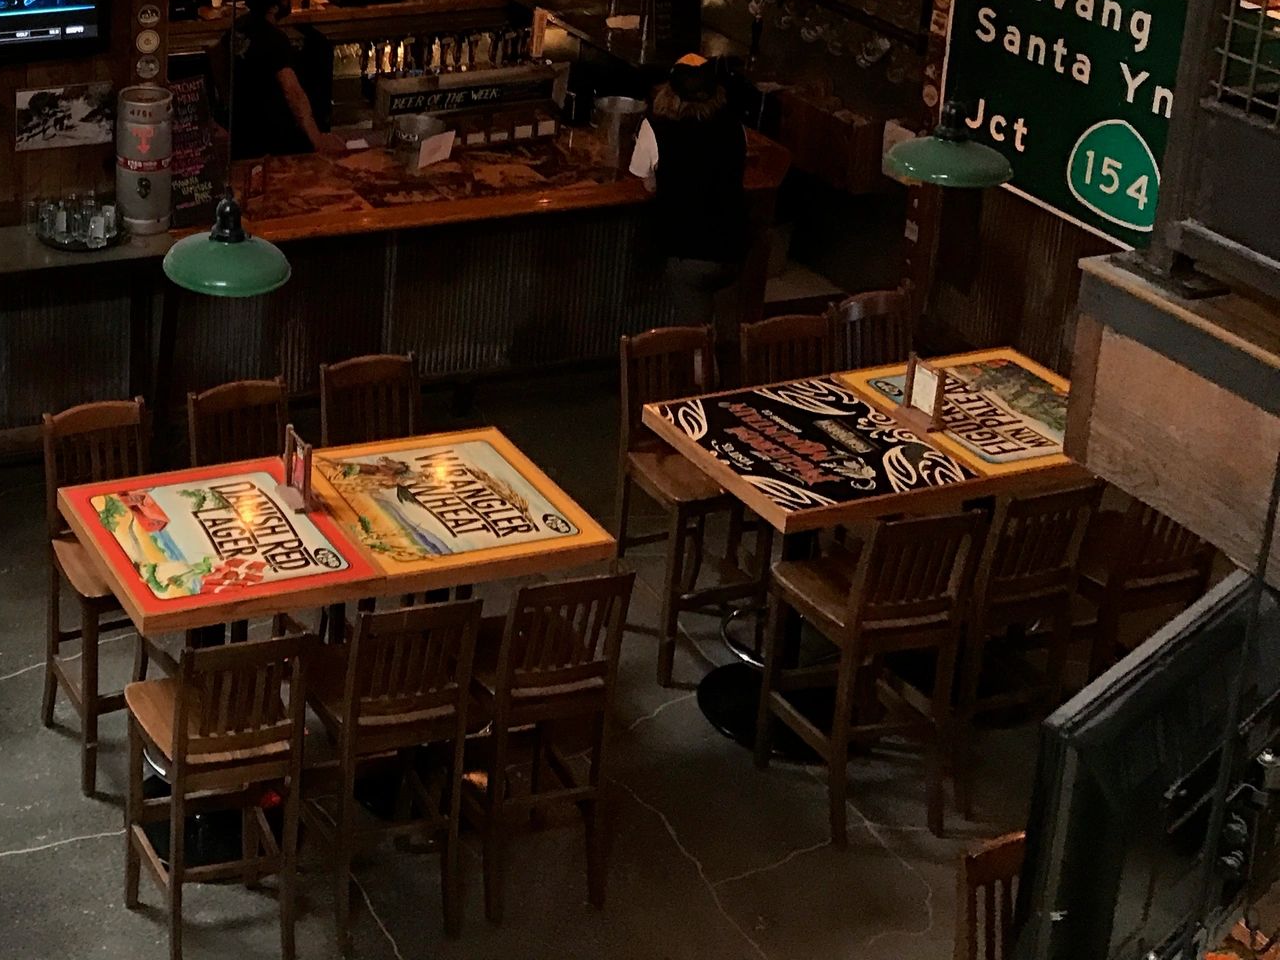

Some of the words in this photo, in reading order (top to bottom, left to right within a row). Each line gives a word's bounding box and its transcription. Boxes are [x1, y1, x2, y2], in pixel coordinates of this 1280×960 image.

[975, 7, 1092, 84] Santa
[1120, 62, 1174, 119] Yn
[392, 96, 424, 110] BEER
[965, 98, 1028, 152] Jct
[1084, 150, 1150, 210] 154
[942, 400, 1027, 455] FIGUER
[953, 395, 1023, 427] PALE
[410, 482, 492, 535] WHEAT
[415, 450, 534, 537] WRANGLER
[192, 506, 258, 560] LAGER
[209, 481, 290, 538] DANISH
[257, 537, 312, 571] RED
